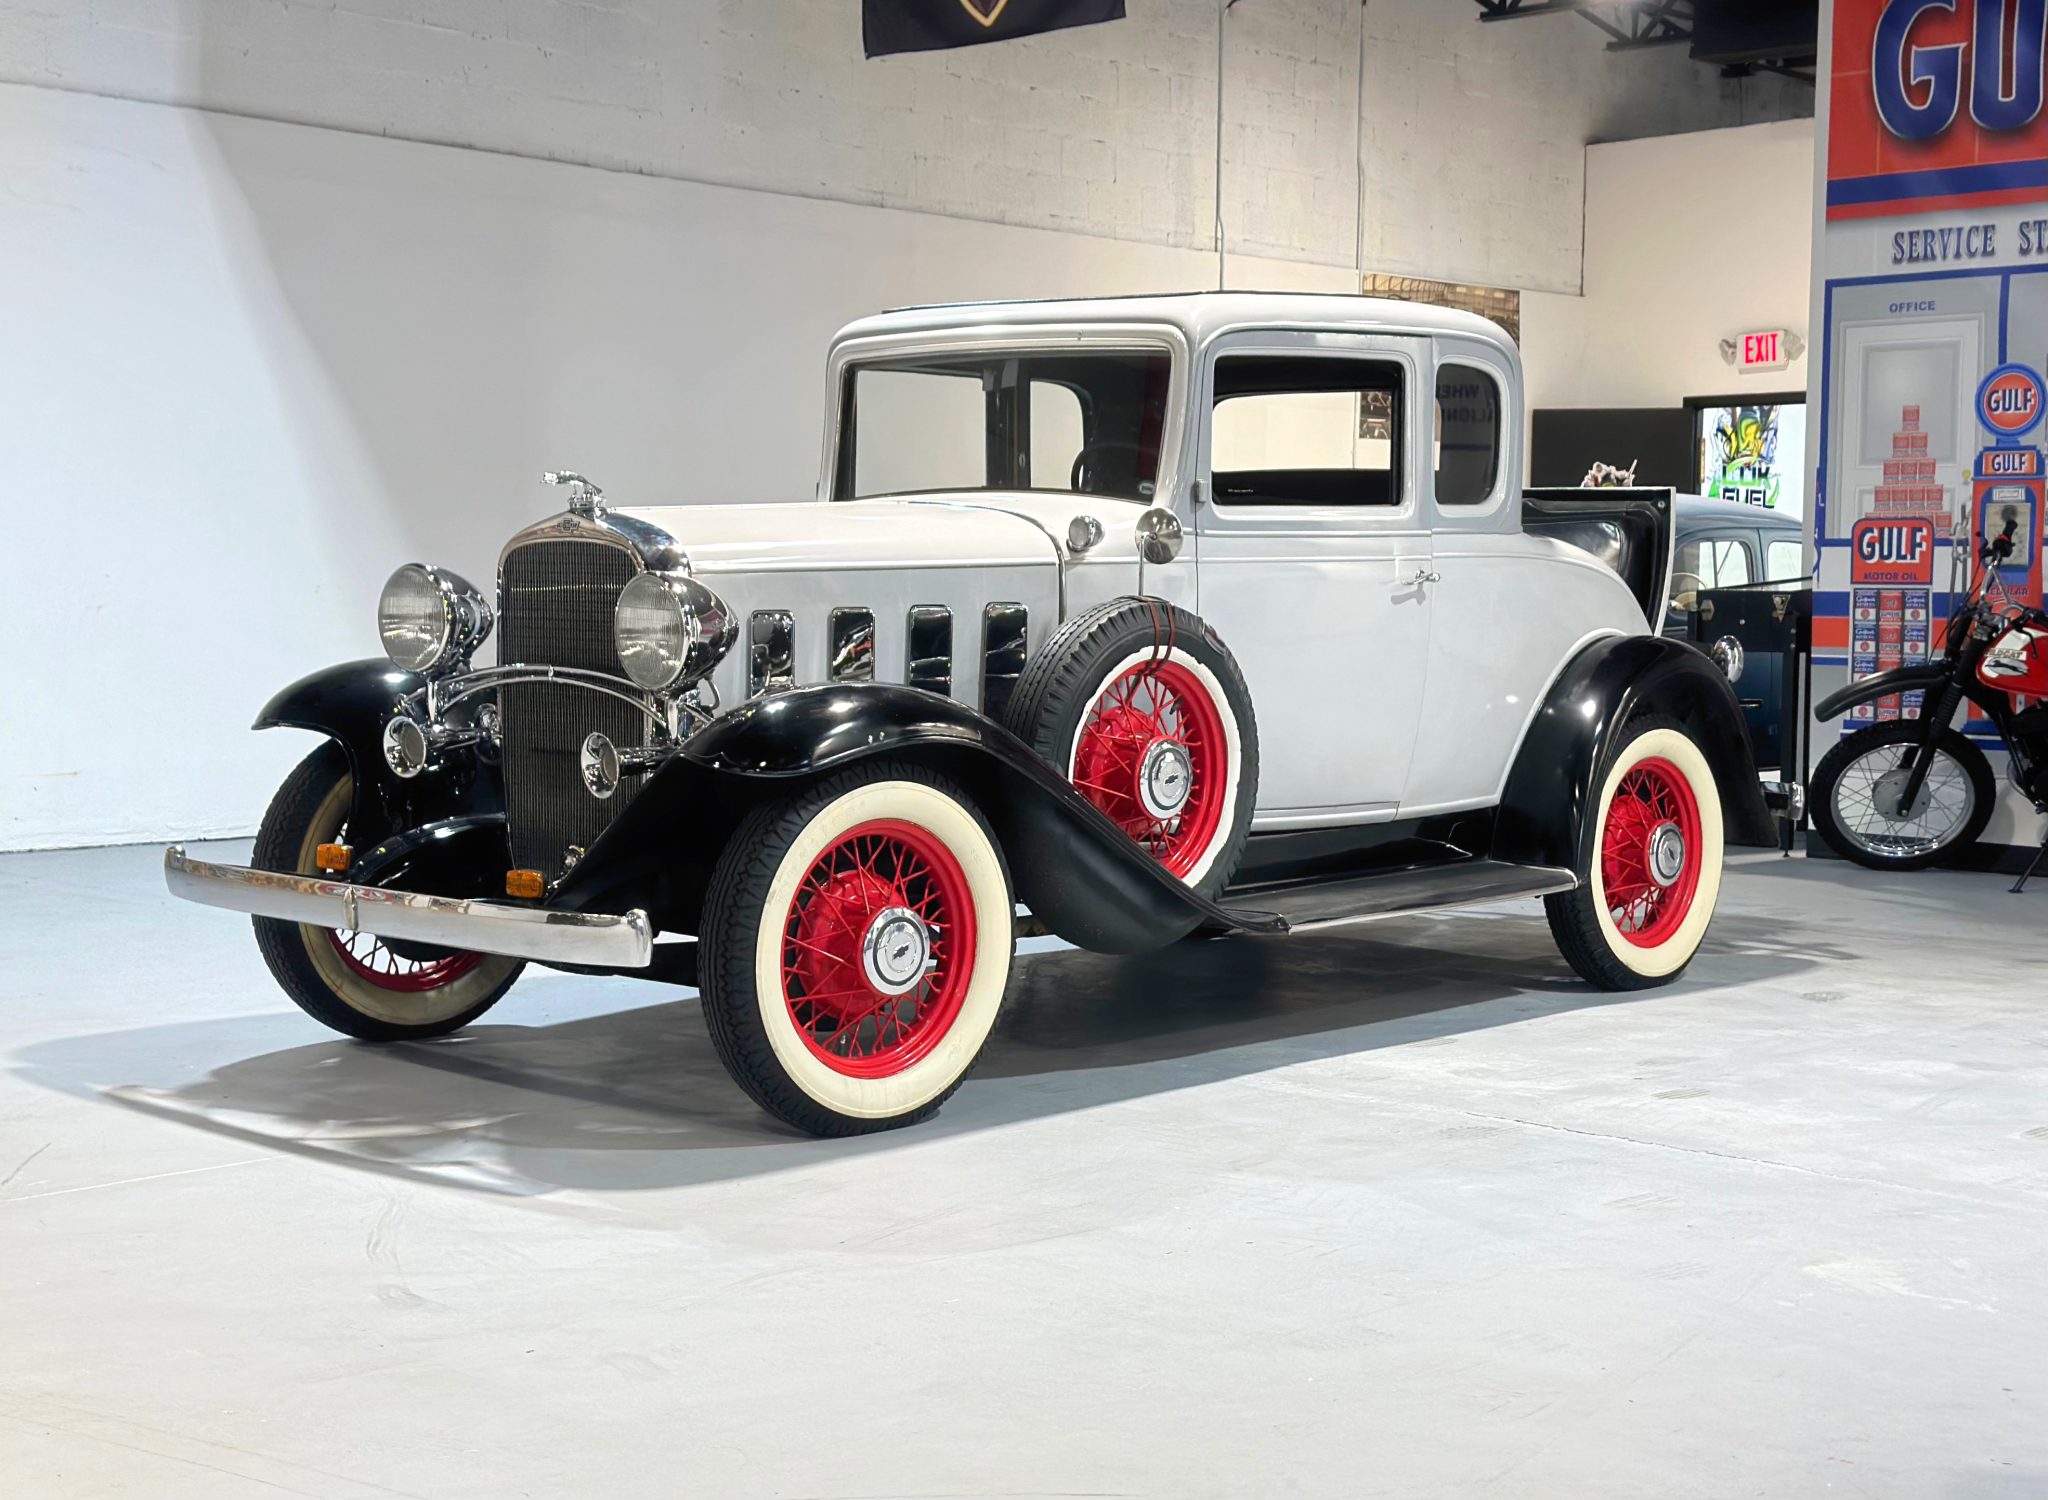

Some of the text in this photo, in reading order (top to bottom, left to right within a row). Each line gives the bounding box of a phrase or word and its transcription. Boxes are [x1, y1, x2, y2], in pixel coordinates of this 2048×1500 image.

[1892, 219, 2048, 264] SERVICE ST
[1889, 301, 1936, 313] OFFICE
[1744, 332, 1779, 364] EXIT
[1987, 387, 2035, 413] GULF
[1991, 452, 2027, 472] GULF
[1859, 526, 1927, 564] GULF
[1863, 572, 1918, 581] MOTOR OIL
